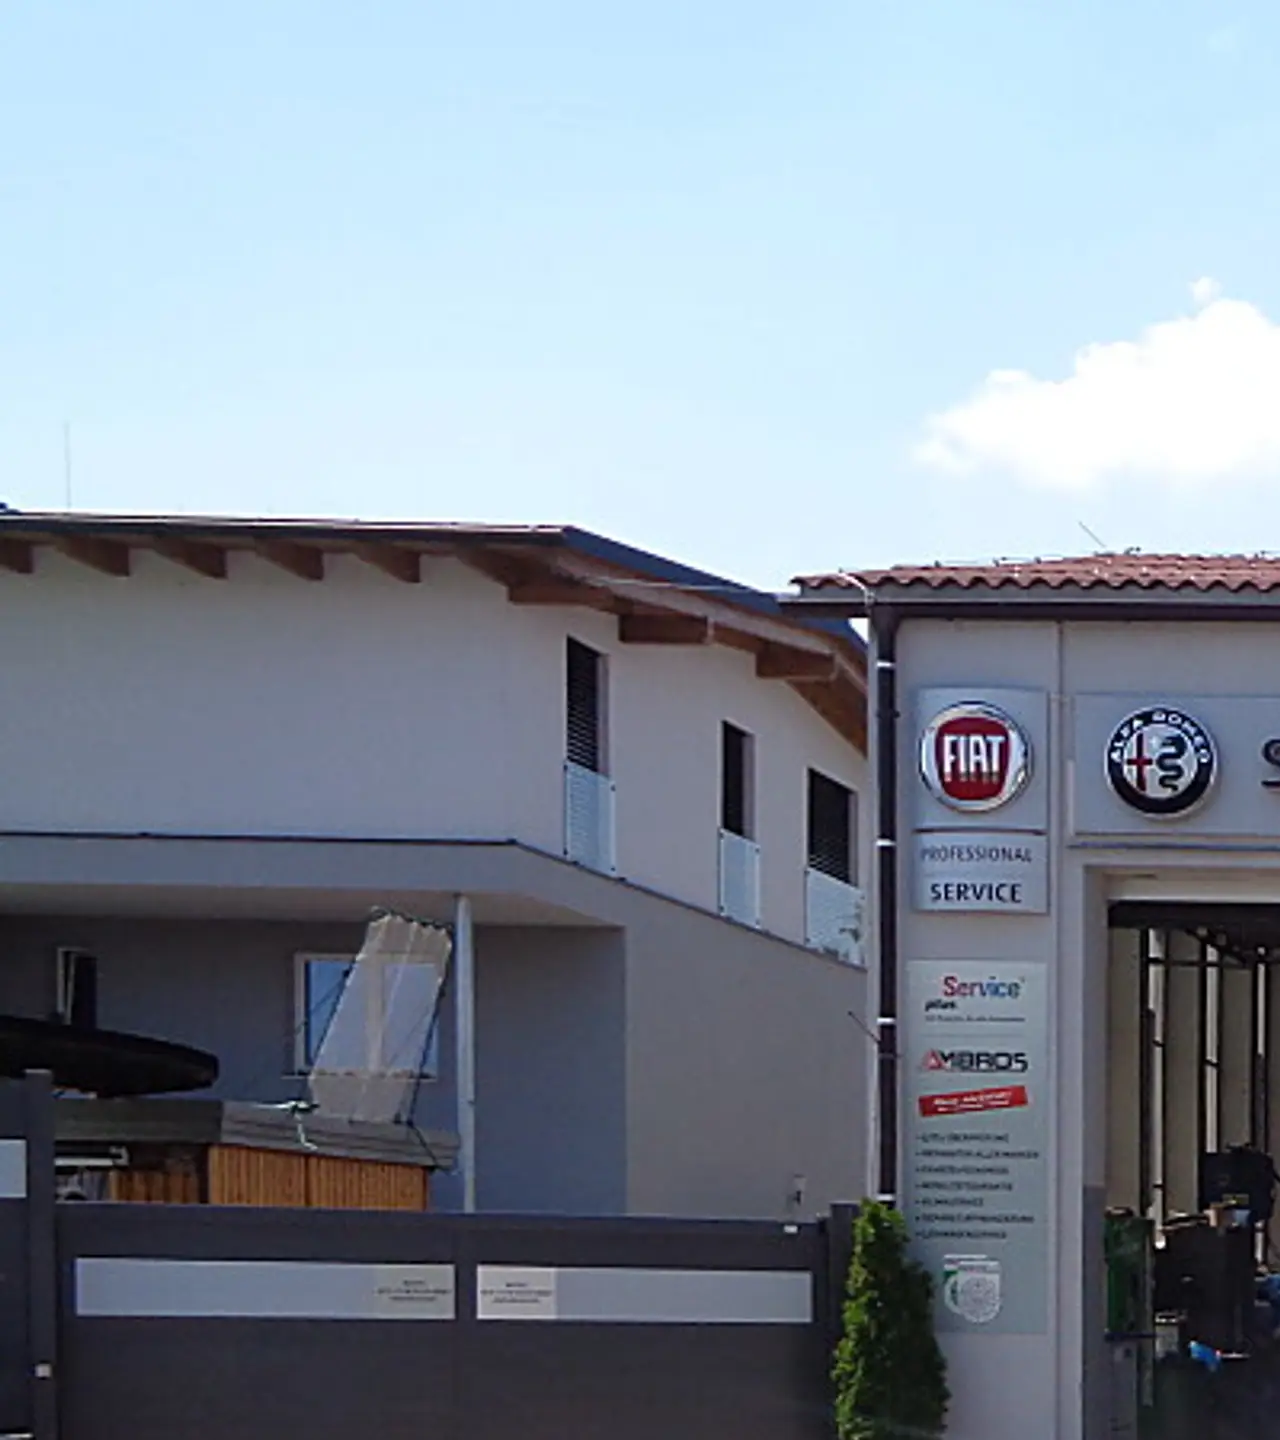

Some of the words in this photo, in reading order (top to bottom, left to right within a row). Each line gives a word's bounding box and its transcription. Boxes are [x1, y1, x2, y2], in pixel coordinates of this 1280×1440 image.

[1110, 718, 1144, 763] ALFA
[1151, 710, 1211, 764] ROMEO
[942, 734, 1007, 784] FIAT
[921, 845, 1032, 862] PROFESSIONAL
[930, 882, 1023, 903] SERVICE
[943, 975, 1020, 999] Service
[922, 1047, 1029, 1073] AMBROS
